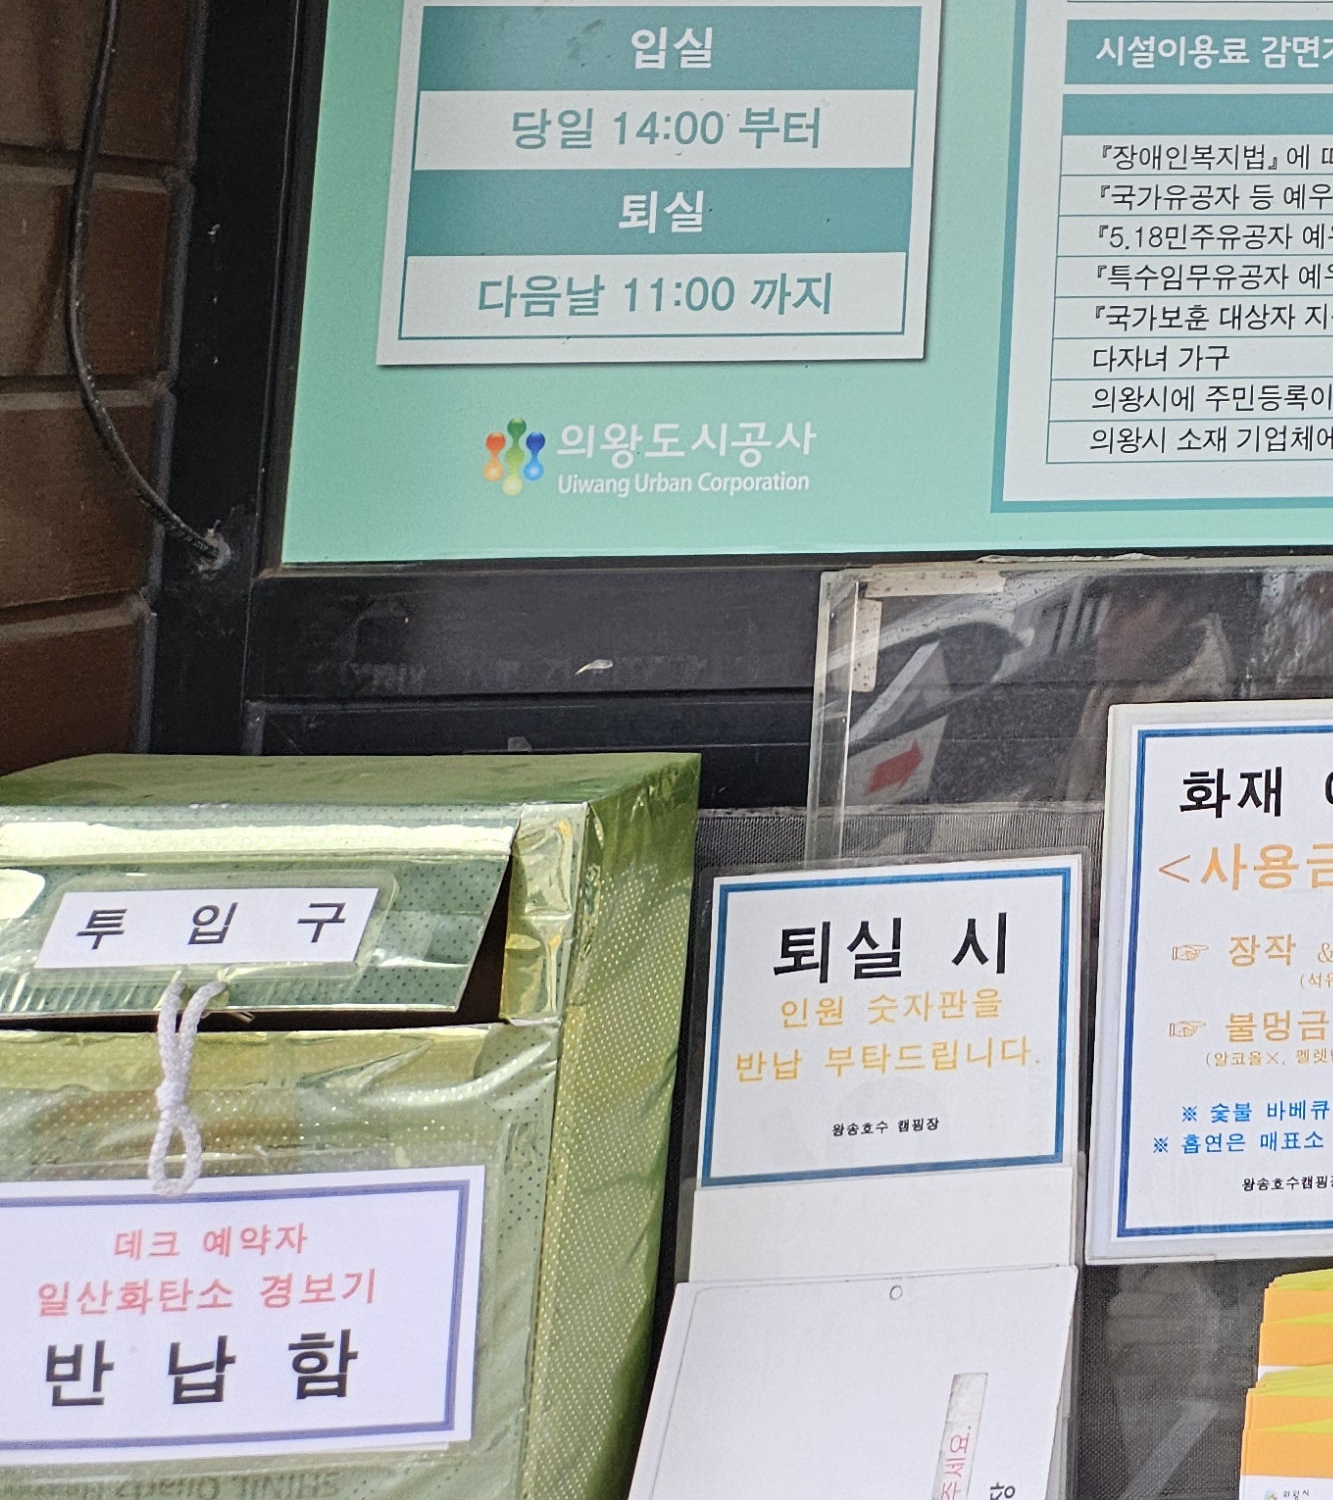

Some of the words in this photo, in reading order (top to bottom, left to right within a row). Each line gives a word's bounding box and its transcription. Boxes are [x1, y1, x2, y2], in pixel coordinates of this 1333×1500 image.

[632, 27, 712, 69] 입실
[1096, 35, 1250, 69] 시설이용료
[513, 108, 593, 149] 당일
[614, 111, 723, 145] 14:00
[739, 107, 820, 149] 부터
[619, 191, 704, 233] 퇴실
[479, 275, 605, 318] 다음날
[625, 277, 734, 312] 11:00
[751, 273, 831, 315] 까지
[1094, 345, 1167, 372] 다자녀
[1092, 386, 1194, 413] 의왕시에
[1206, 384, 1331, 412] 주민등록이
[557, 422, 816, 469] 의왕도시공사
[1090, 427, 1165, 454] 의왕시
[559, 474, 630, 498] Uiwang
[635, 472, 692, 492] Urban
[698, 471, 809, 496] Corporation
[1180, 767, 1281, 818] 화재
[774, 918, 901, 983] 퇴실
[952, 912, 1006, 974] 시
[1229, 934, 1296, 967] 장작
[781, 996, 843, 1028] 인원
[868, 989, 1002, 1025] 숫자판을
[737, 1049, 802, 1082] 반납
[824, 1036, 1039, 1077] 부탁드립니다.
[833, 1121, 888, 1137] 왕송호수
[898, 1118, 939, 1132] 캠핑장
[1211, 1103, 1252, 1123] 숯불
[1182, 1133, 1245, 1154] 흡연은
[1261, 1131, 1323, 1151] 매표소
[114, 1229, 180, 1260] 데크
[203, 1223, 308, 1257] 예약자
[38, 1278, 233, 1317] 일산화탄소
[259, 1269, 375, 1308] 경보기
